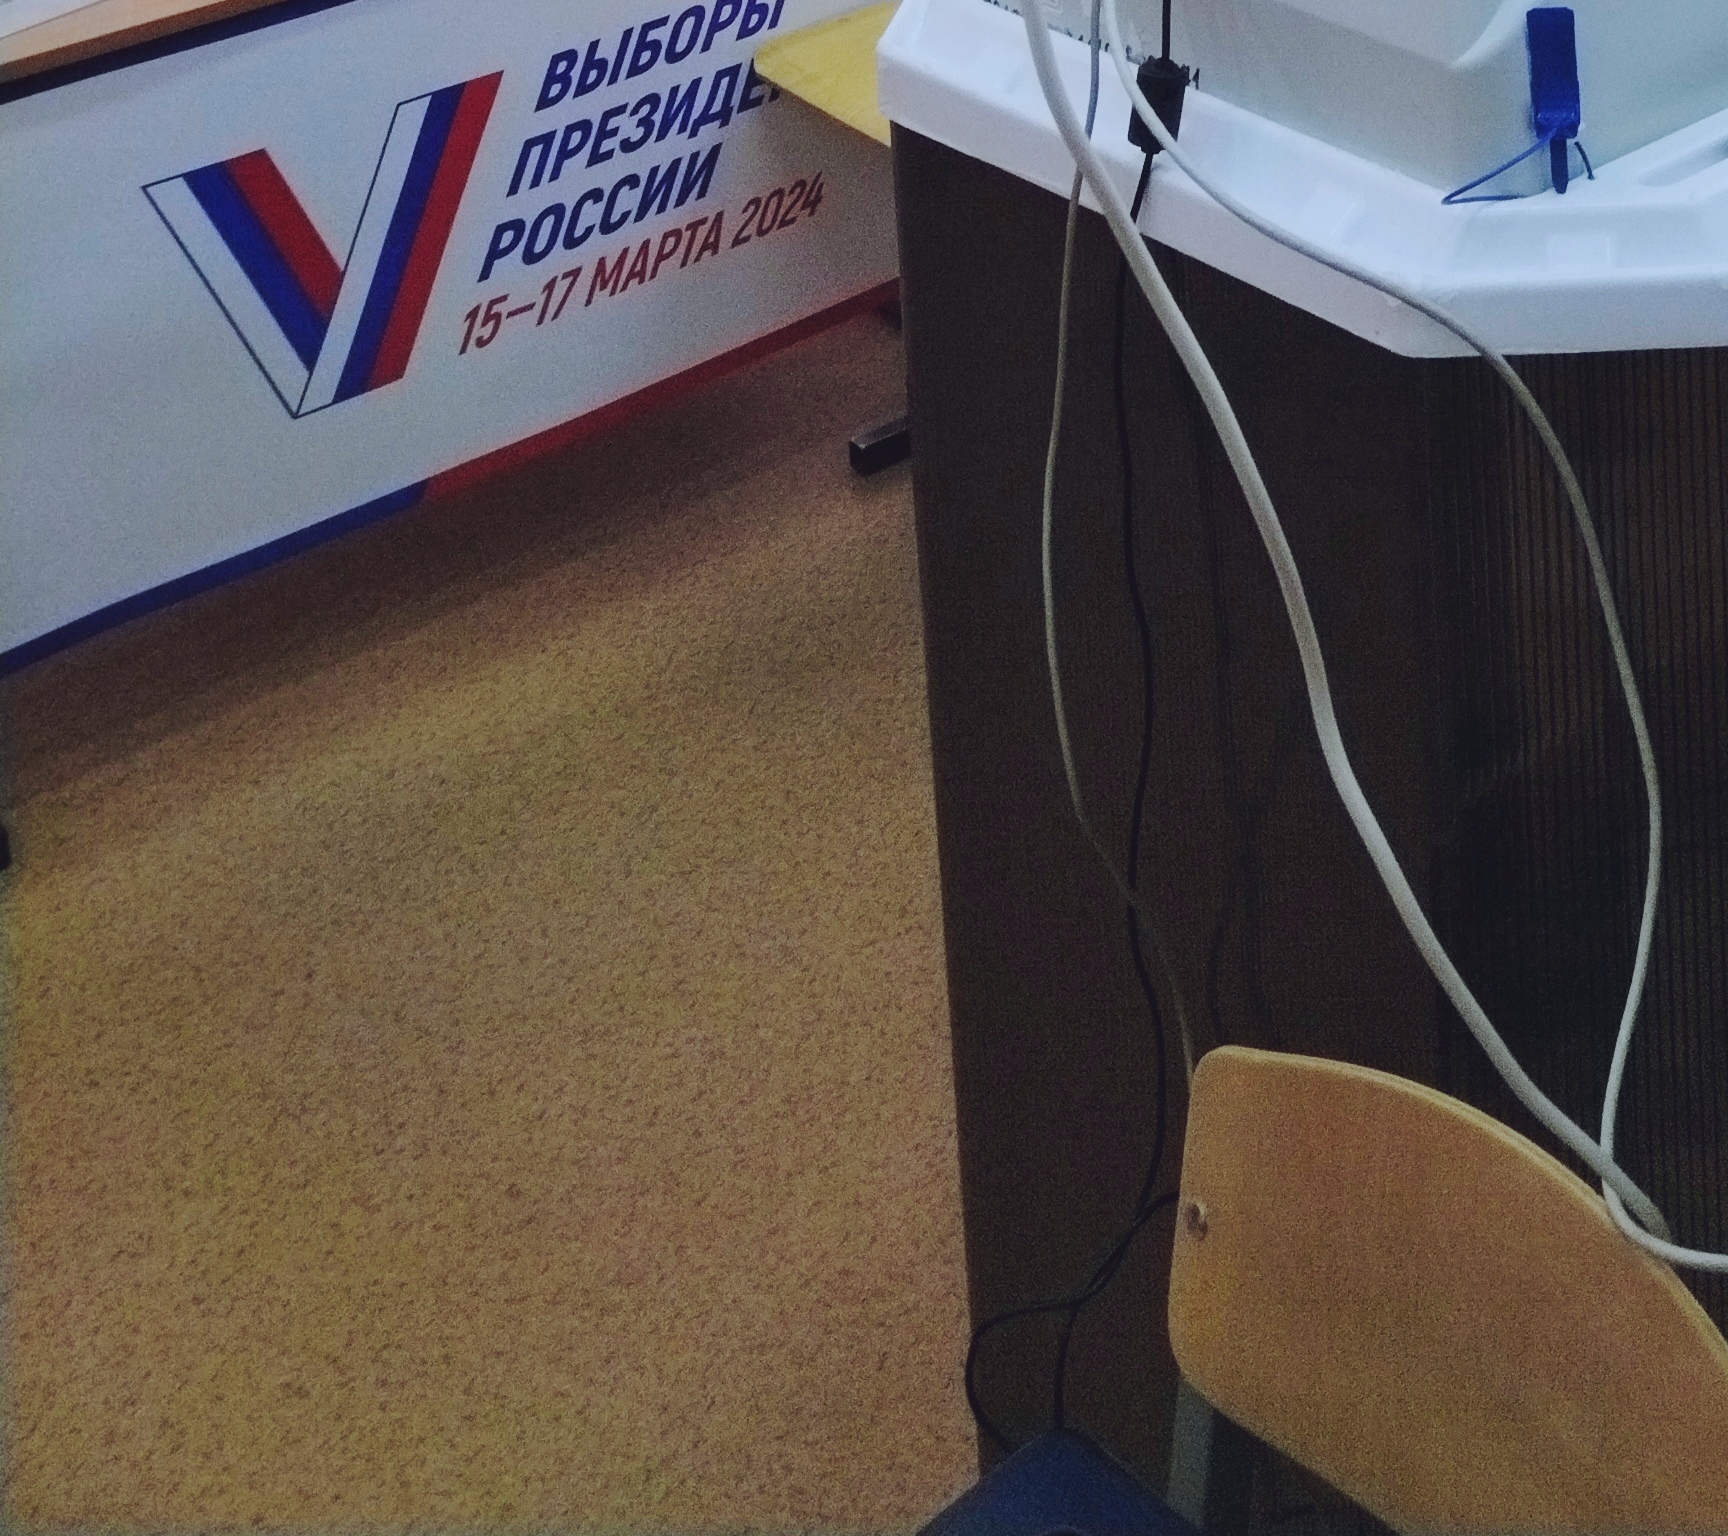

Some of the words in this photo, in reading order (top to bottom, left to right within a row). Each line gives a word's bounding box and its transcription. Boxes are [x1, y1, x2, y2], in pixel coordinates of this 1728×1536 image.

[476, 141, 724, 284] РОССИИ
[584, 211, 726, 308] МАРТА
[730, 170, 826, 249] 2024
